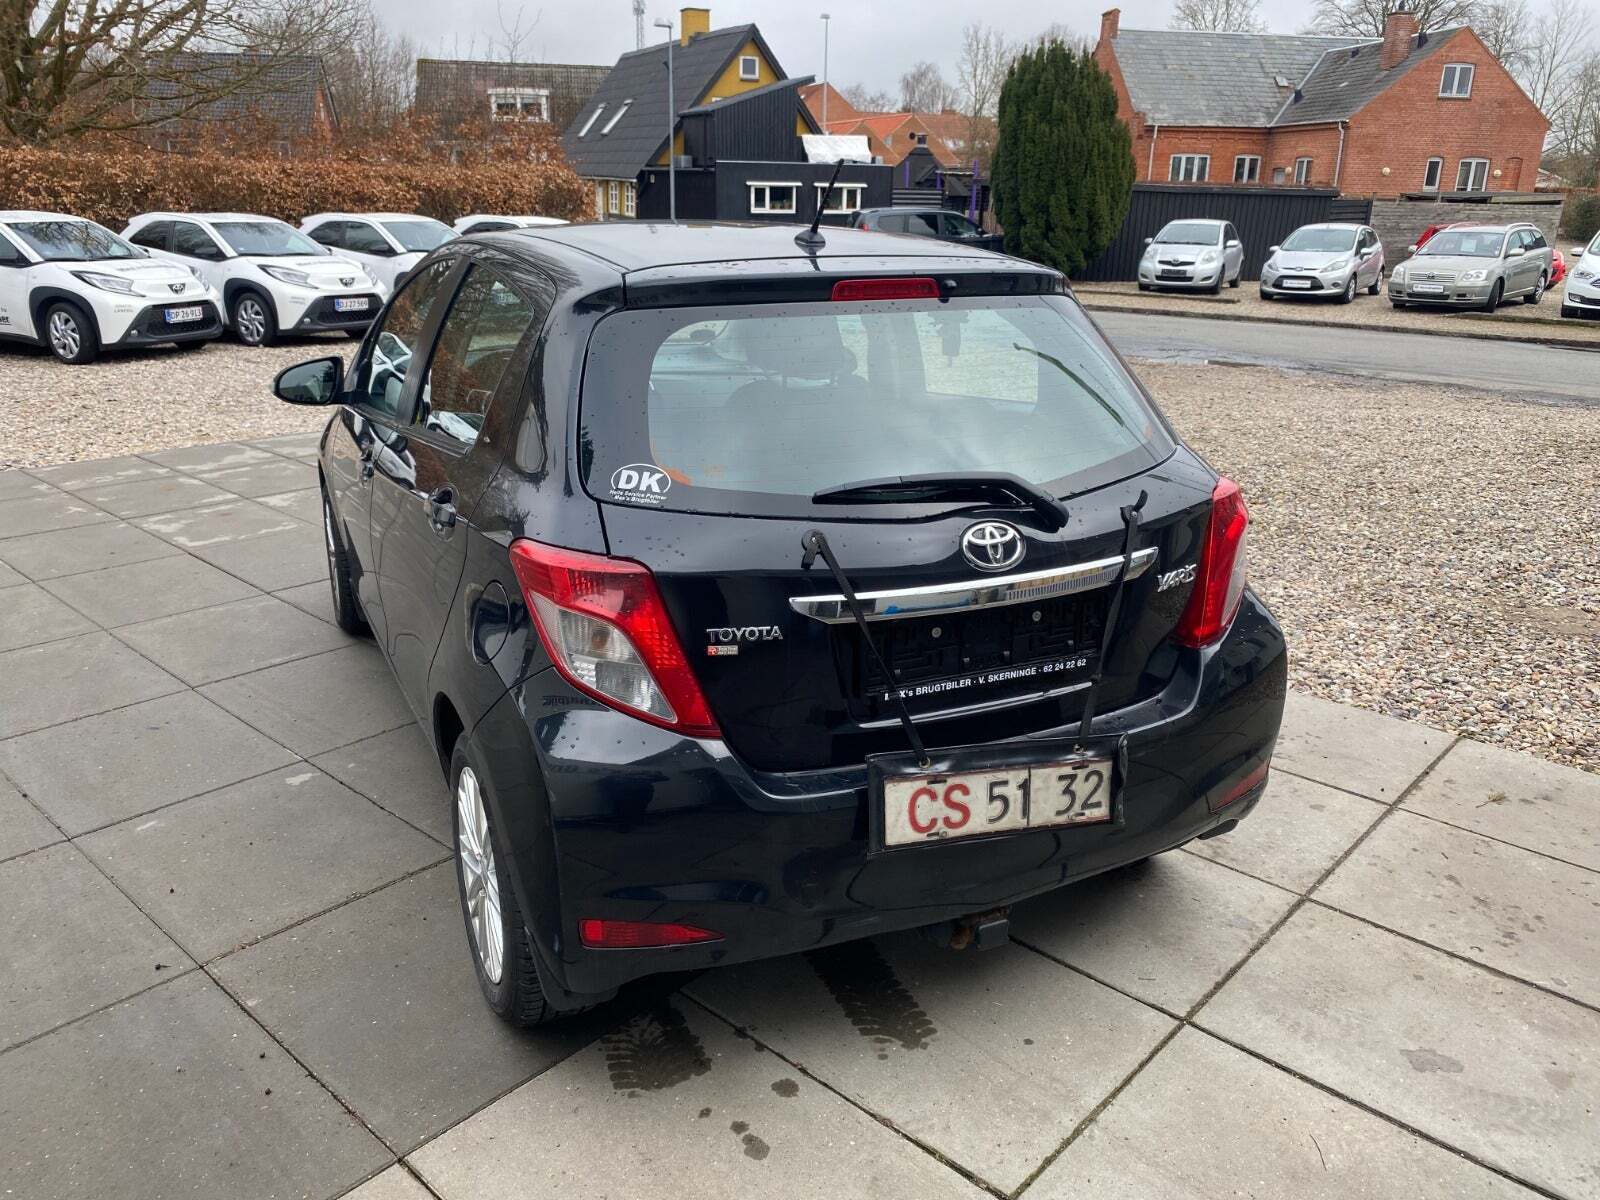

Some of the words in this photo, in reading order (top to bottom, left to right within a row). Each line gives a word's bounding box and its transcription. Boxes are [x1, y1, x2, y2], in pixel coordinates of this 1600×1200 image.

[617, 469, 664, 493] DK
[1157, 563, 1197, 592] YARIS
[706, 625, 783, 643] TOYOTA
[915, 678, 972, 696] BRUGTBILER
[978, 676, 987, 685] V.
[987, 667, 1037, 683] SKERNINGE
[1043, 664, 1053, 673] 62
[1054, 663, 1064, 671] 24
[1065, 660, 1075, 669] 22
[1076, 658, 1087, 667] 62
[908, 783, 971, 833] CS
[986, 778, 1031, 824] 51
[1055, 769, 1105, 816] 32
